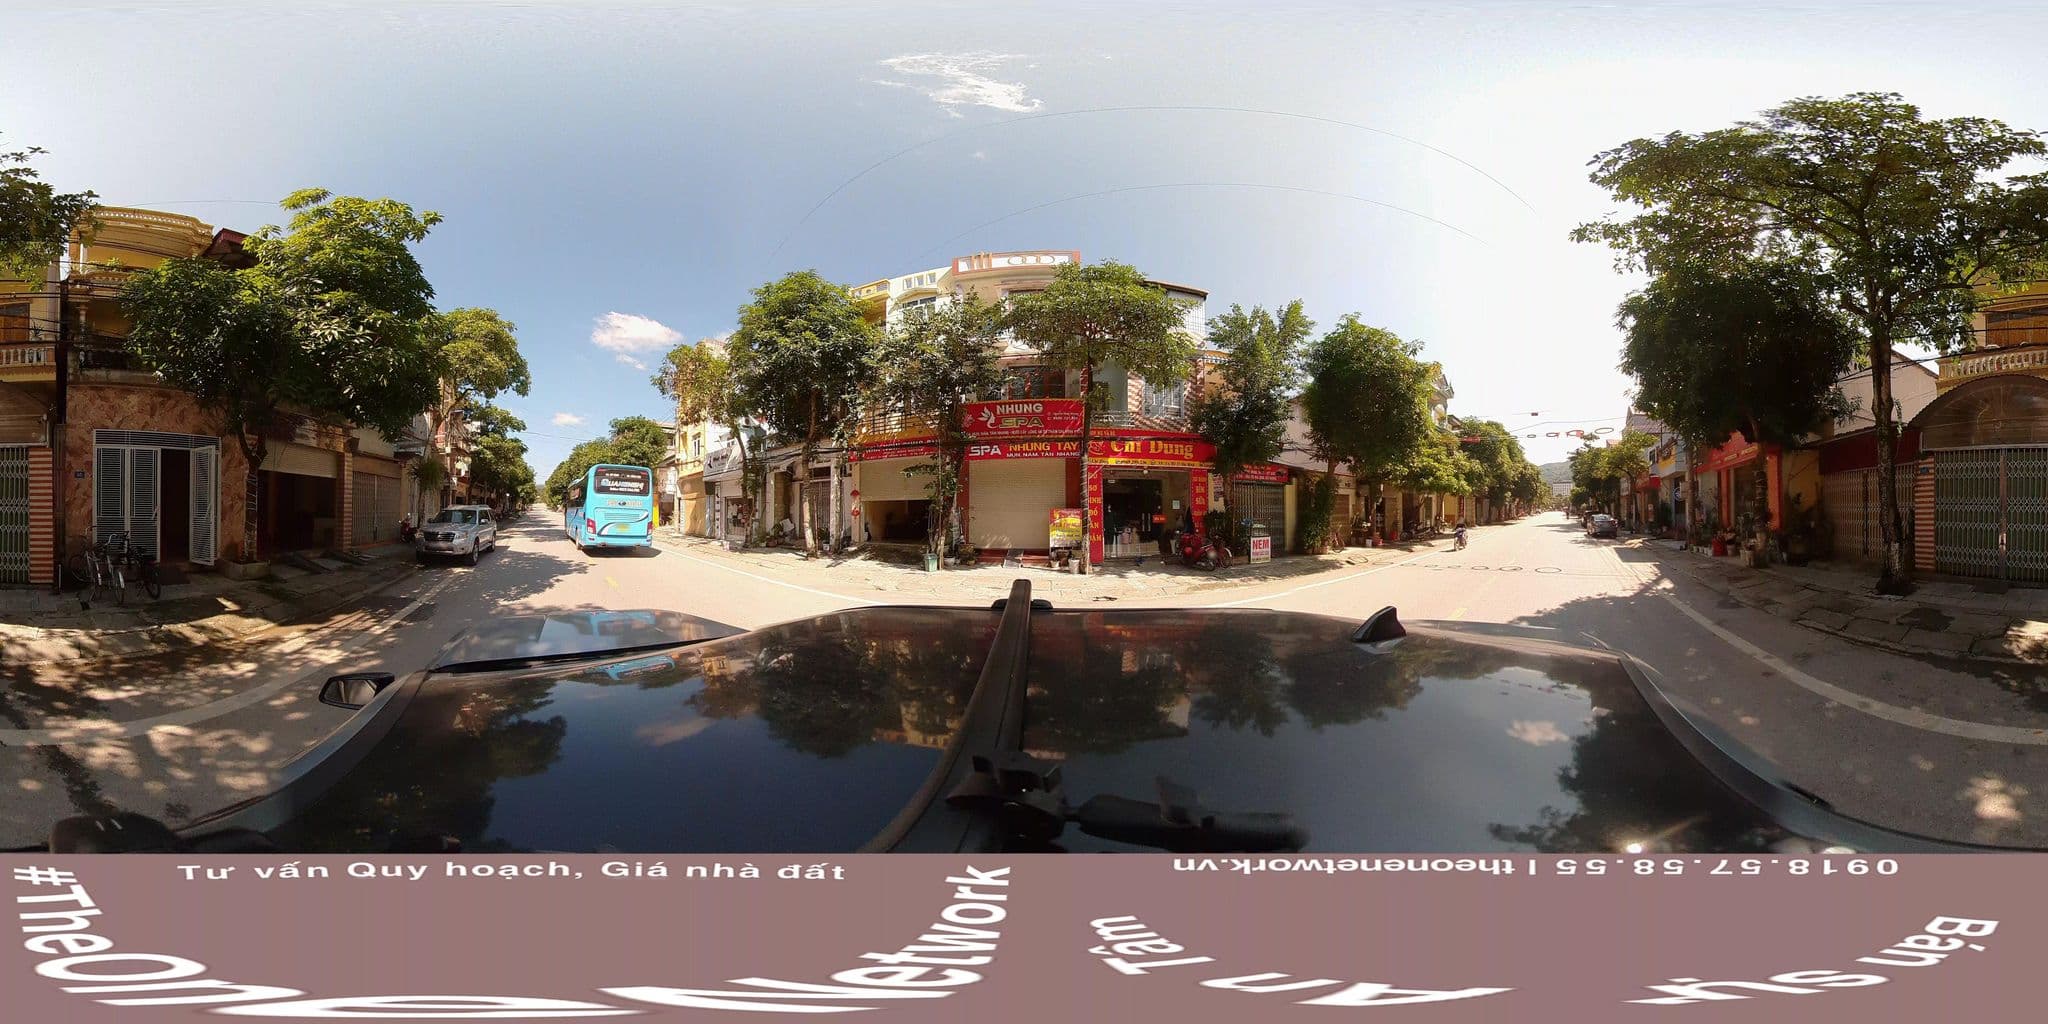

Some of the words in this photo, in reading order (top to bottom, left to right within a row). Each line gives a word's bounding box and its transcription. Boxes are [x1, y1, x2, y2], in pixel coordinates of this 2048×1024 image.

[997, 403, 1042, 415] NHUNG
[999, 416, 1044, 428] SPA
[969, 445, 1001, 456] SPA
[1009, 442, 1051, 452] NHUNG
[1056, 441, 1079, 451] TAY
